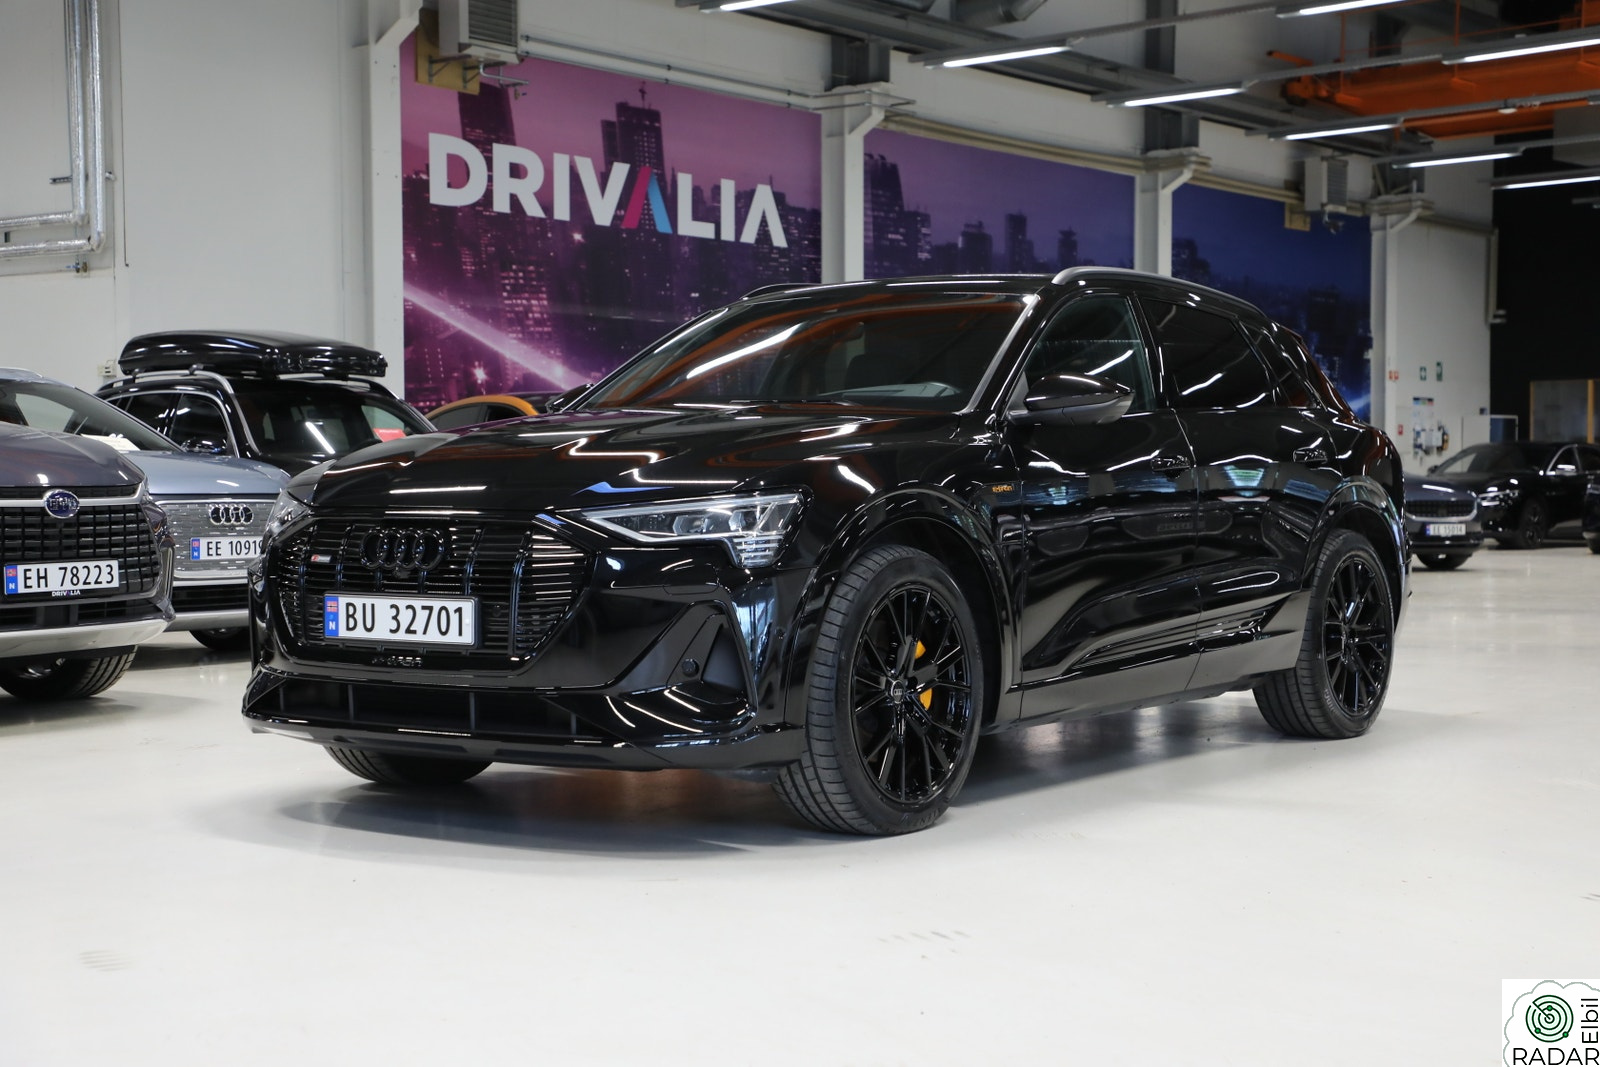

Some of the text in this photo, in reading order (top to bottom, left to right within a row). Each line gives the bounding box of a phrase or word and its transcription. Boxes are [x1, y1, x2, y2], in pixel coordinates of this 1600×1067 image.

[428, 132, 788, 248] DRIVALIA
[207, 541, 221, 556] EE
[24, 564, 114, 589] EH 78223
[329, 621, 336, 630] N
[345, 602, 463, 637] BU 32701
